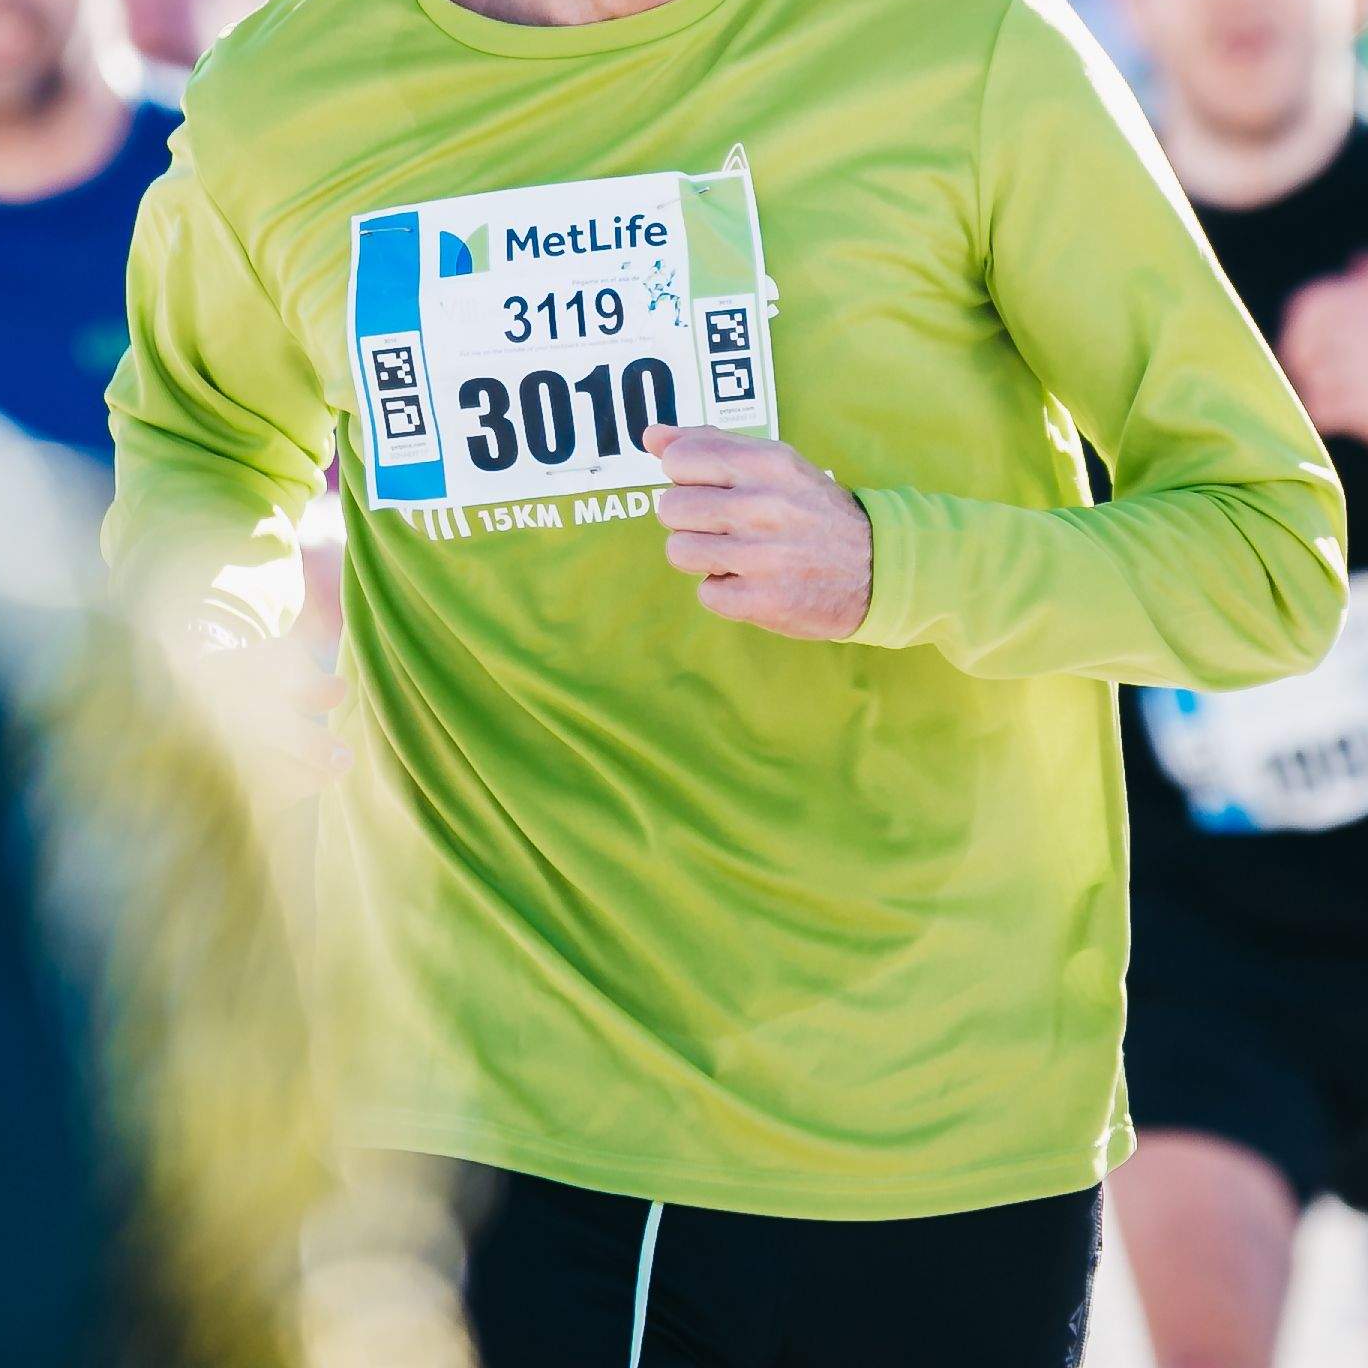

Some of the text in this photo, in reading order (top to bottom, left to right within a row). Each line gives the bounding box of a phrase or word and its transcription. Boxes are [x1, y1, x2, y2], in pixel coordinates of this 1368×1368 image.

[506, 214, 668, 262] MetLife
[503, 287, 625, 344] 3119
[458, 357, 679, 472] 3010
[478, 503, 563, 532] 15KM
